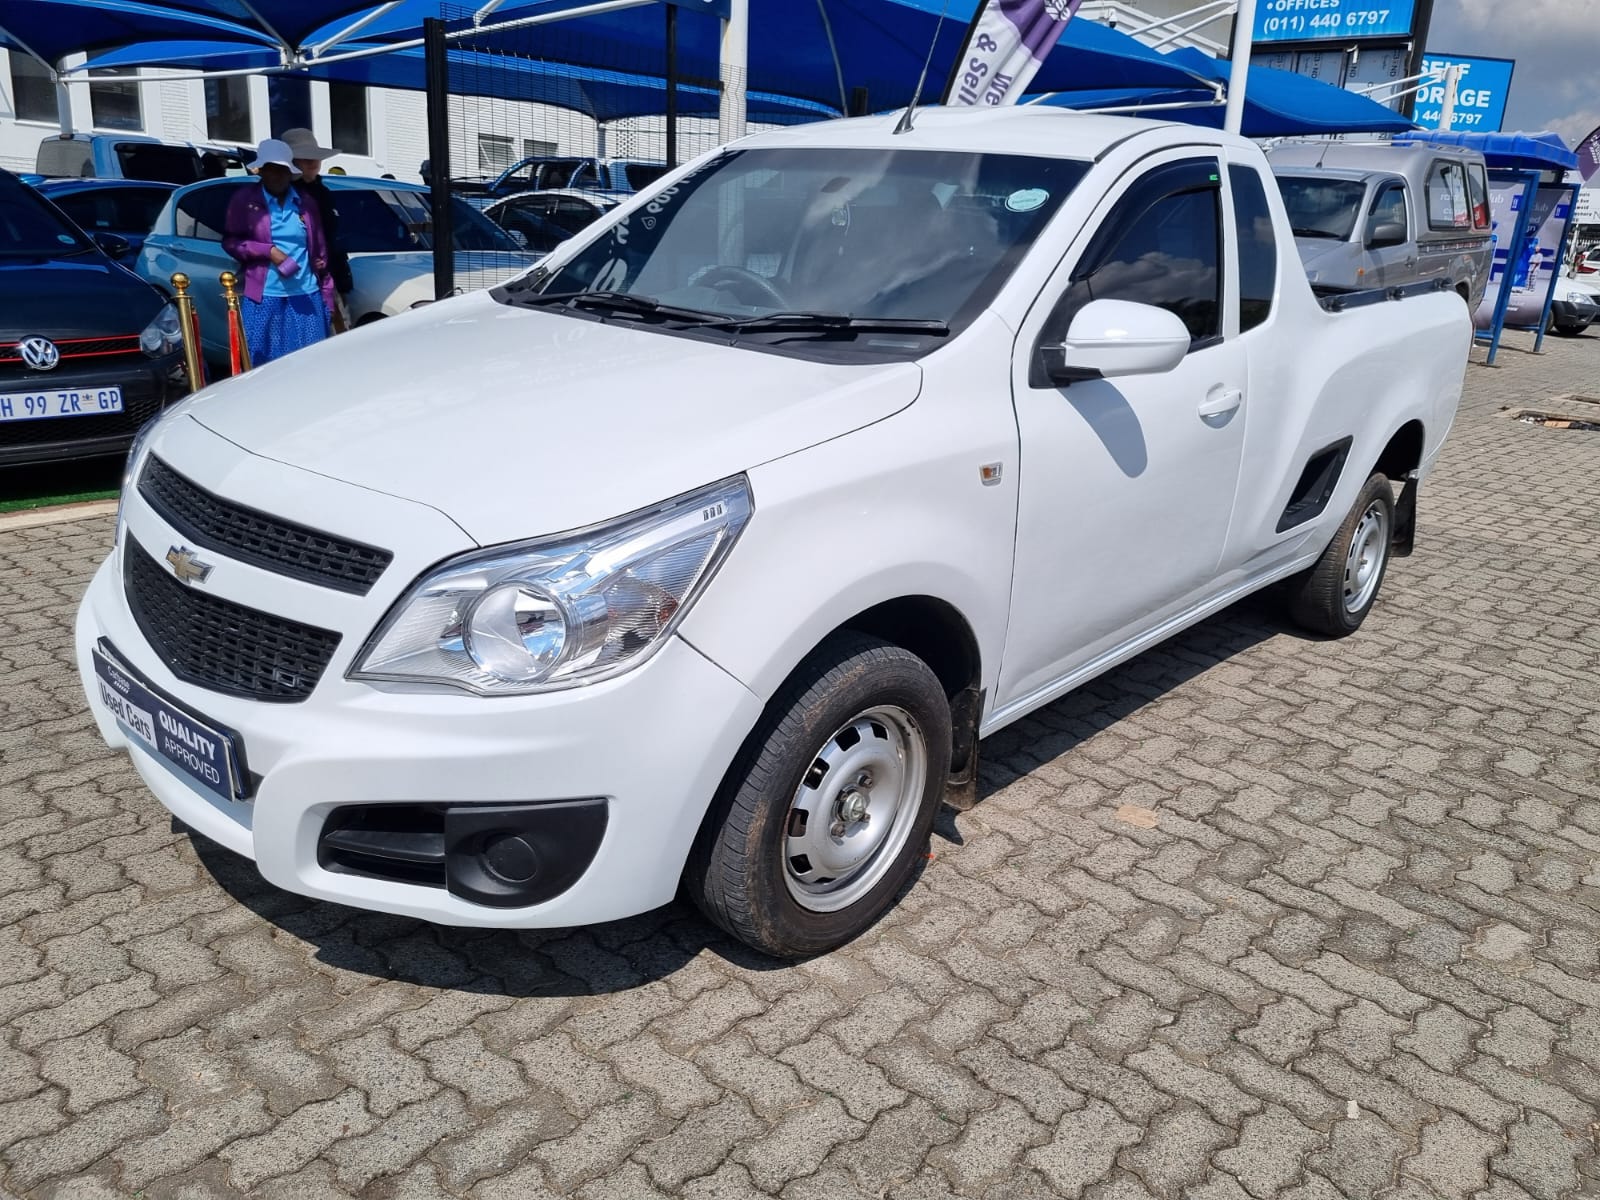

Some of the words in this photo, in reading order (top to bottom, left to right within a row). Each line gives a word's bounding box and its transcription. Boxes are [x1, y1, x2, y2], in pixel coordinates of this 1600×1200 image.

[976, 33, 998, 53] &
[1263, 15, 1305, 34] (011)
[1310, 13, 1341, 28] 440
[1346, 10, 1390, 26] 6797
[958, 57, 989, 106] Sell
[0, 397, 14, 418] H
[24, 395, 47, 416] 99
[58, 393, 82, 414] ZR
[97, 390, 119, 410] GP
[101, 683, 126, 721] Used
[126, 703, 152, 741] Cars
[159, 710, 216, 761] QUALITY
[165, 735, 220, 784] APPROVED
